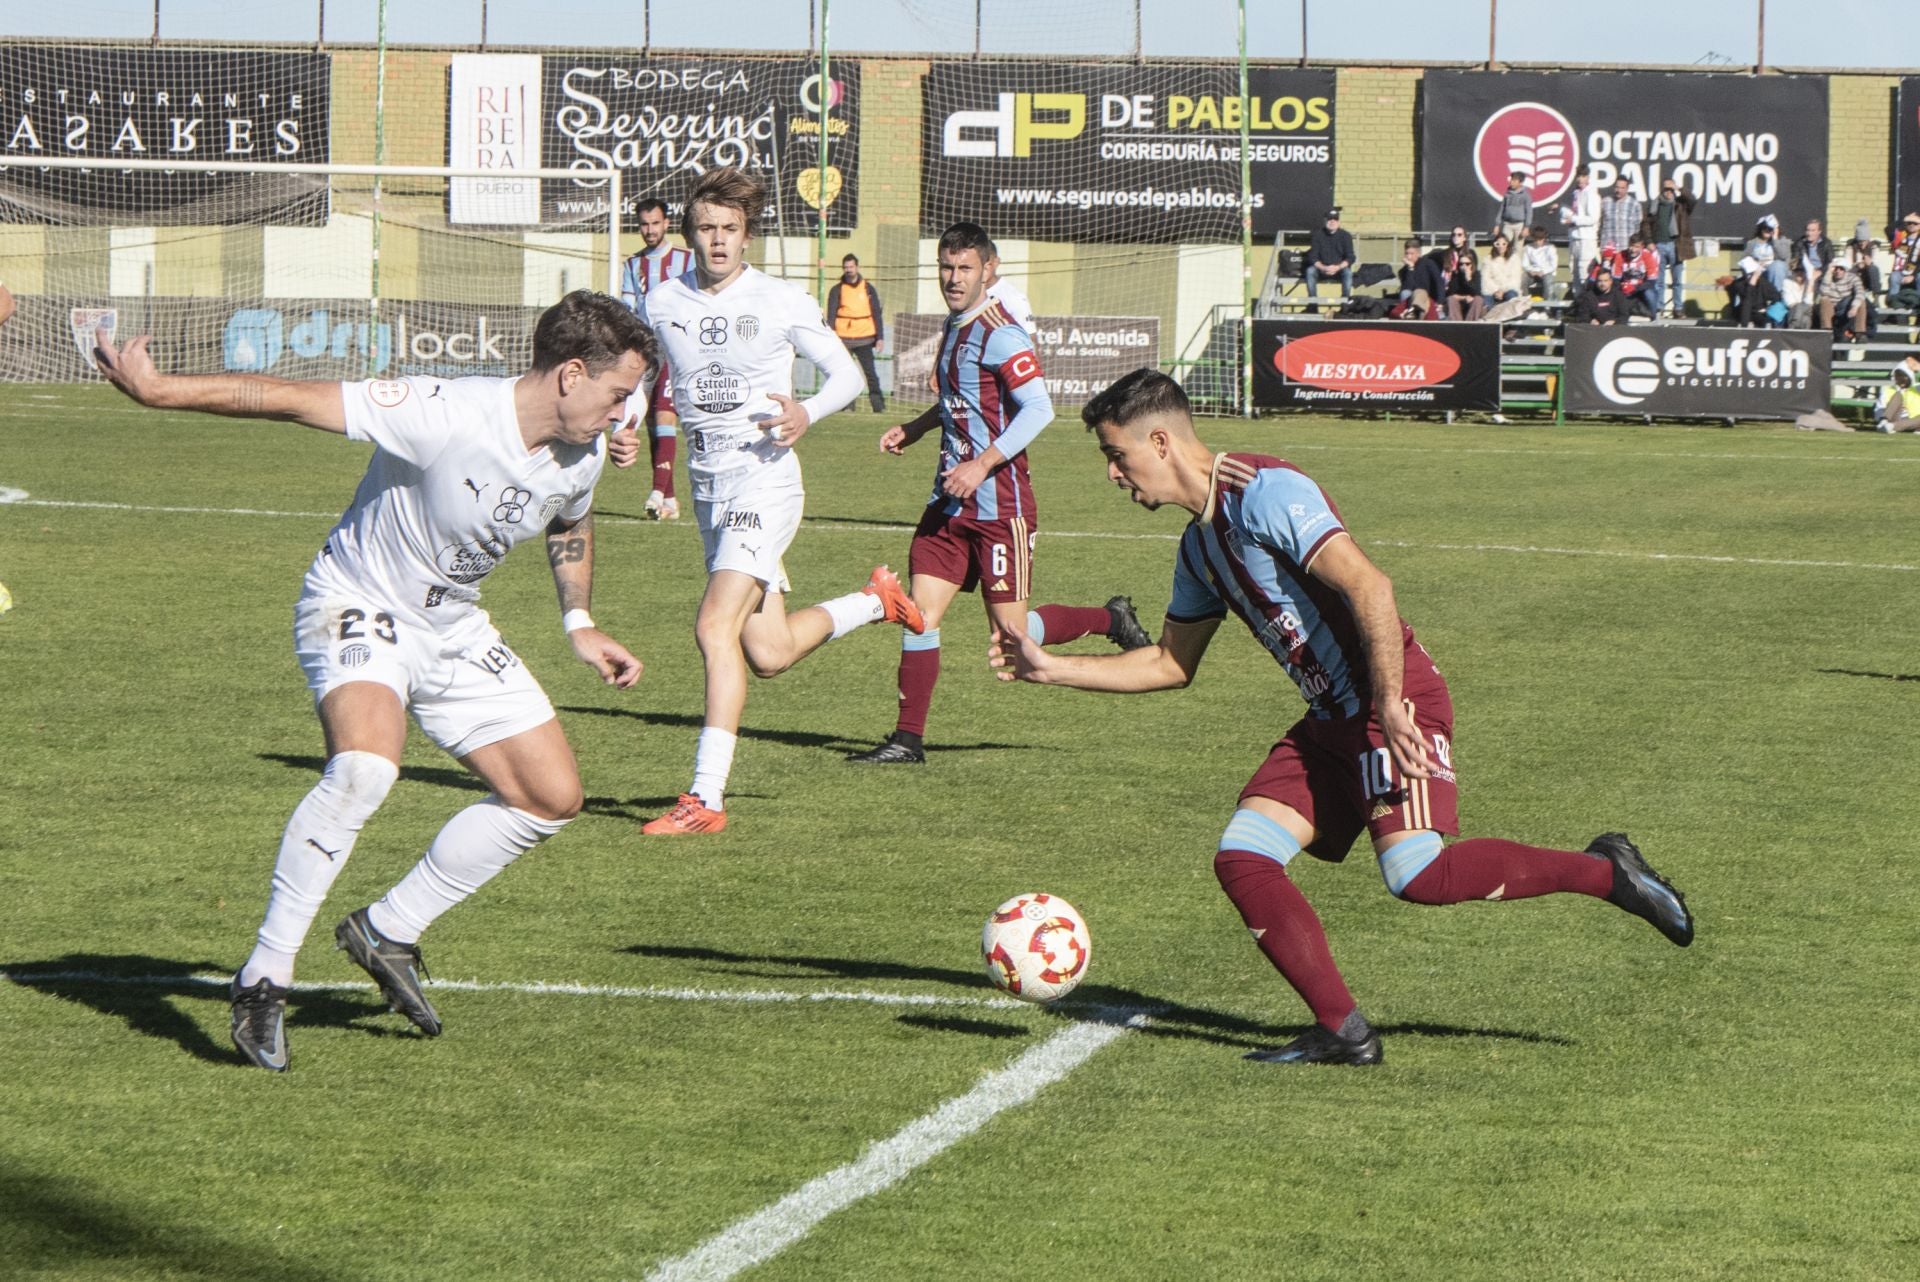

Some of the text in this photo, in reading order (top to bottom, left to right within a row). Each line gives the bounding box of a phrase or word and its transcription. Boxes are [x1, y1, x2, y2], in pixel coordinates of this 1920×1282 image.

[609, 68, 749, 96] BODEGA
[0, 89, 303, 110] STAURANTE
[557, 67, 774, 140] Severino
[1101, 95, 1330, 131] DE PABLOS
[570, 125, 749, 188] Sanzo
[1101, 139, 1329, 163] CORREDURÍA DE SEGUROS
[1588, 130, 1779, 163] OCTAVIANO
[476, 182, 524, 195] DUERO
[1588, 162, 1778, 205] PALOMO
[1036, 328, 1150, 346] tel Avenida
[1056, 347, 1120, 357] del Sotillo
[1662, 338, 1809, 378] eufón
[1012, 355, 1035, 378] C
[1302, 363, 1427, 380] MESTOLAYA
[696, 377, 738, 390] Estrella
[697, 389, 737, 402] Galicia
[1063, 379, 1088, 395] 921
[1293, 387, 1434, 401] Ingeniería y Construcción
[1666, 377, 1806, 390] electricidad
[548, 538, 585, 569] 29
[991, 543, 1007, 576] 6
[340, 608, 398, 645] 23
[1360, 747, 1392, 800] 10
